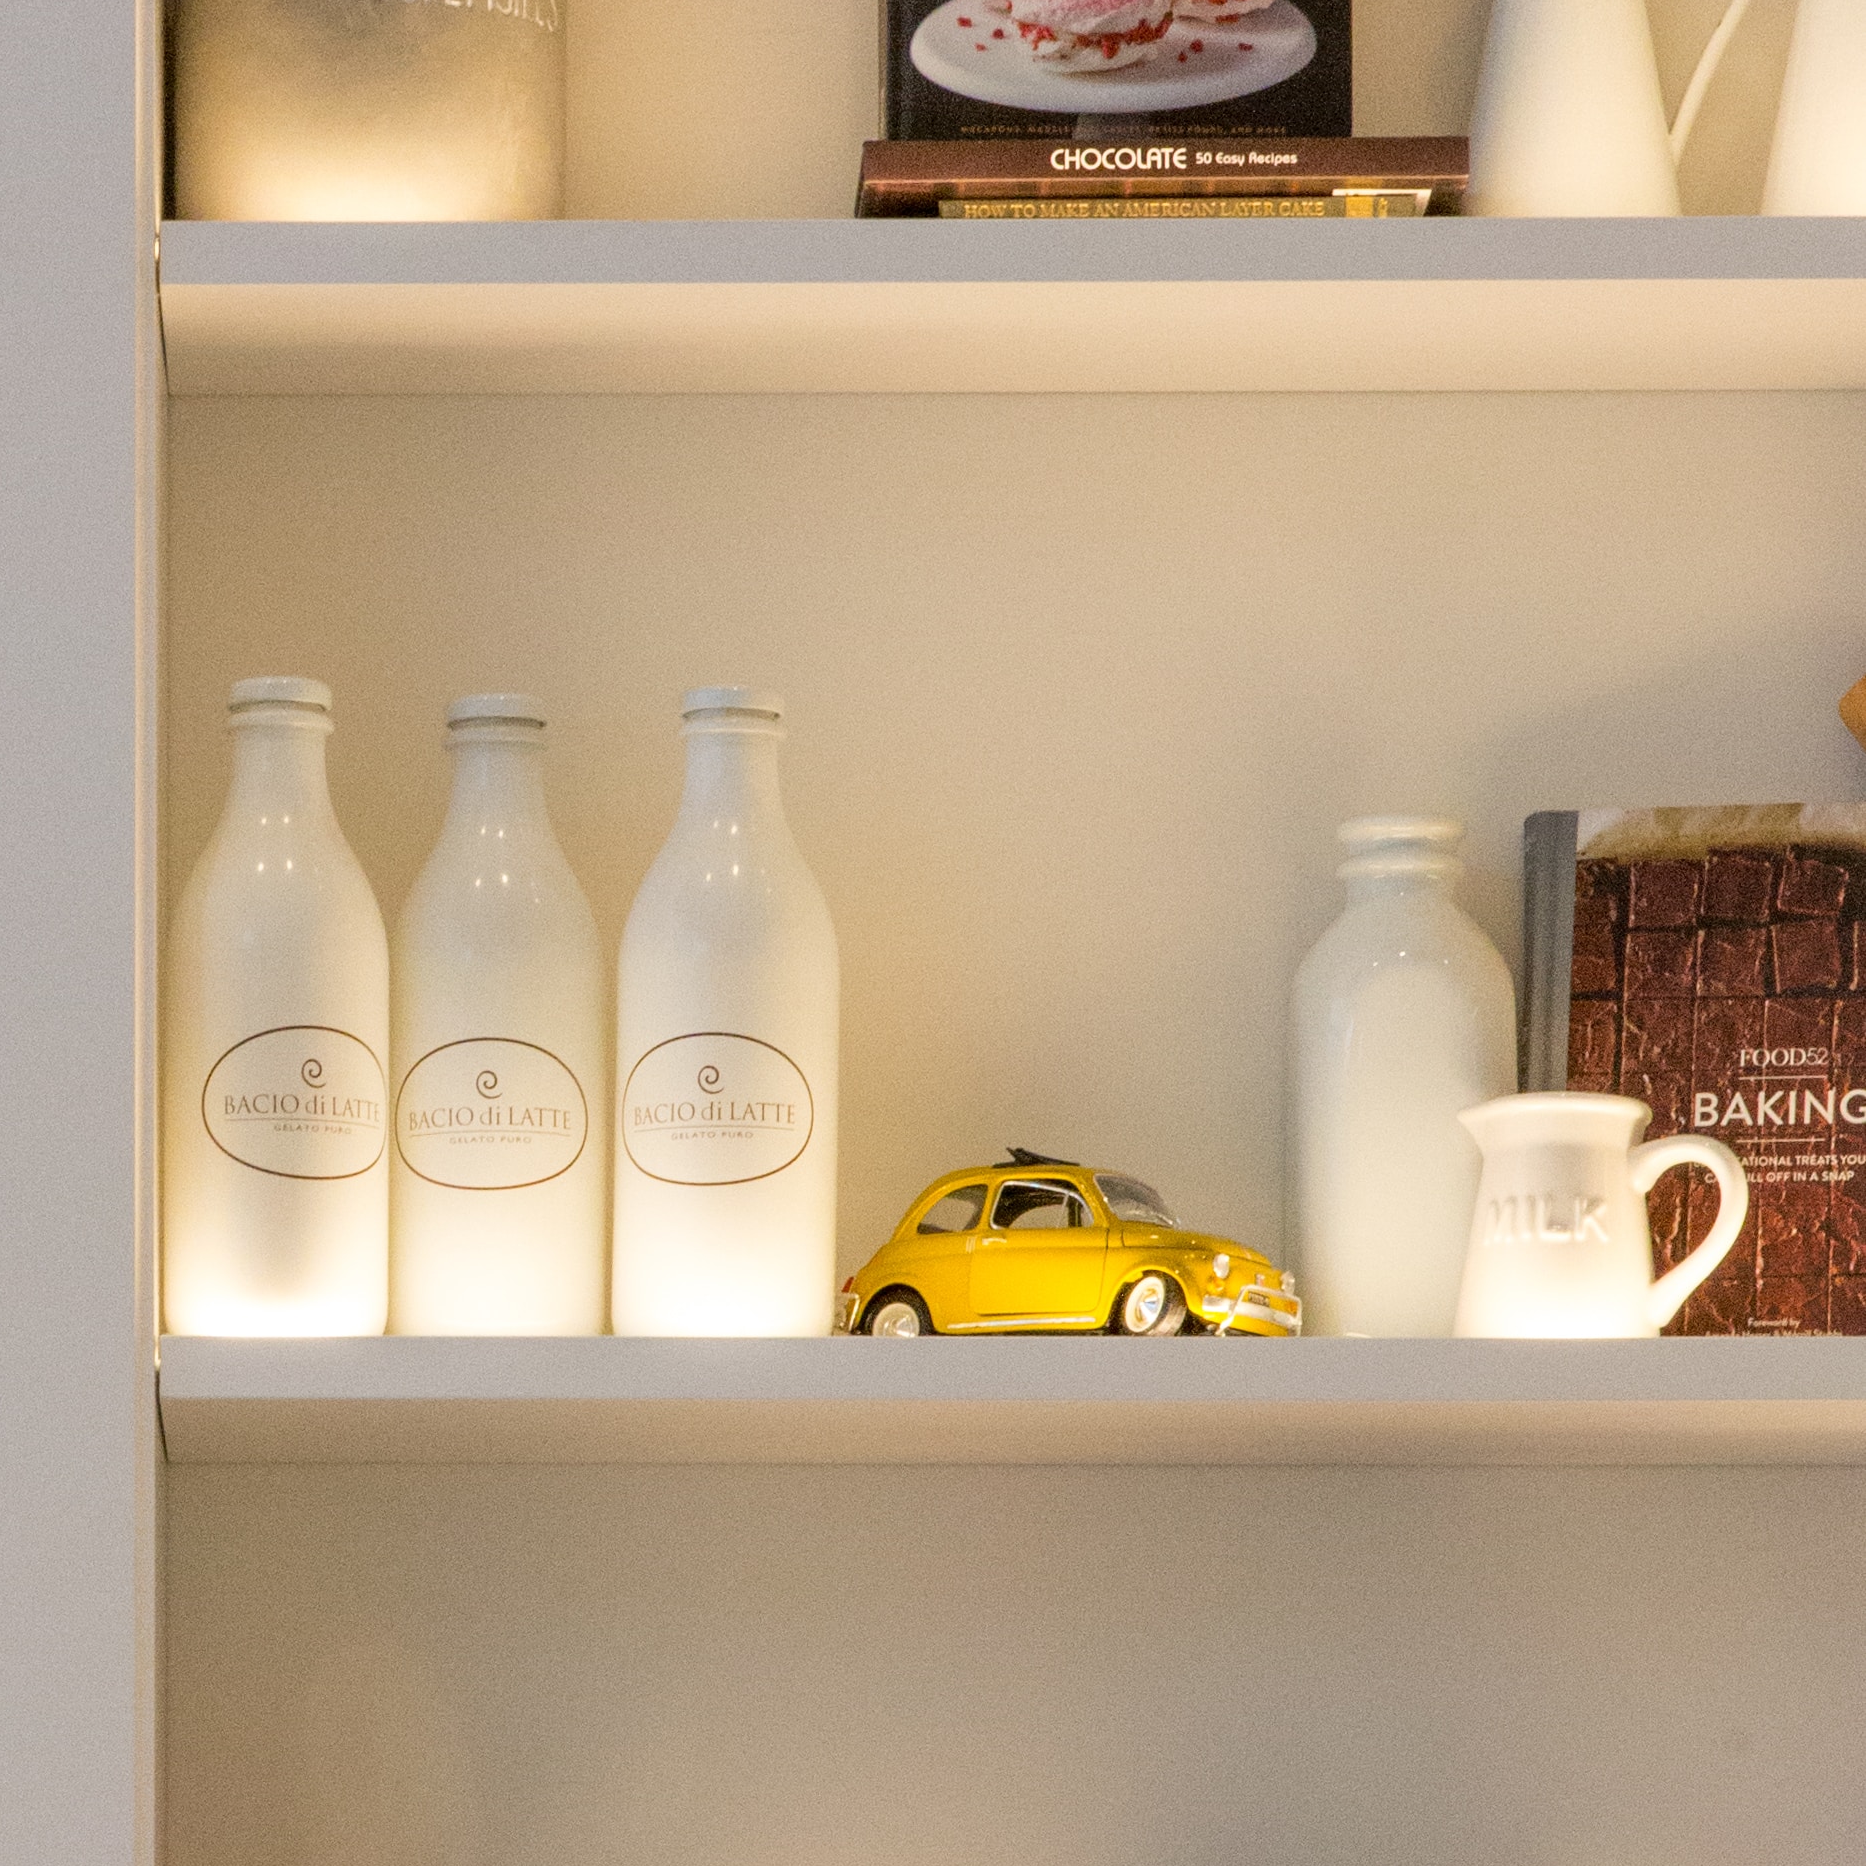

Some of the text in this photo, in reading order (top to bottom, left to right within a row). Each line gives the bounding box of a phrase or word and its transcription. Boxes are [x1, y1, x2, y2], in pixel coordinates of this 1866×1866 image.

[1050, 147, 1298, 170] CHOCOLATE 50 Easy Recipes
[964, 201, 1325, 218] HOW TO MAKE AN AMERICAN LAYER CAKE
[1740, 1047, 1828, 1068] FOOD52
[224, 1093, 380, 1123] BACIO di LATTE
[409, 1105, 572, 1131] BACIO di LATTE
[634, 1100, 796, 1127] BACIO di LATTE
[1693, 1087, 1866, 1127] BAKING
[1795, 1154, 1838, 1166] TREATS
[1766, 1171, 1790, 1182] OFF
[1793, 1171, 1807, 1182] IN
[1809, 1170, 1819, 1182] A
[1822, 1170, 1855, 1182] SNAP
[1483, 1194, 1610, 1246] MILK
